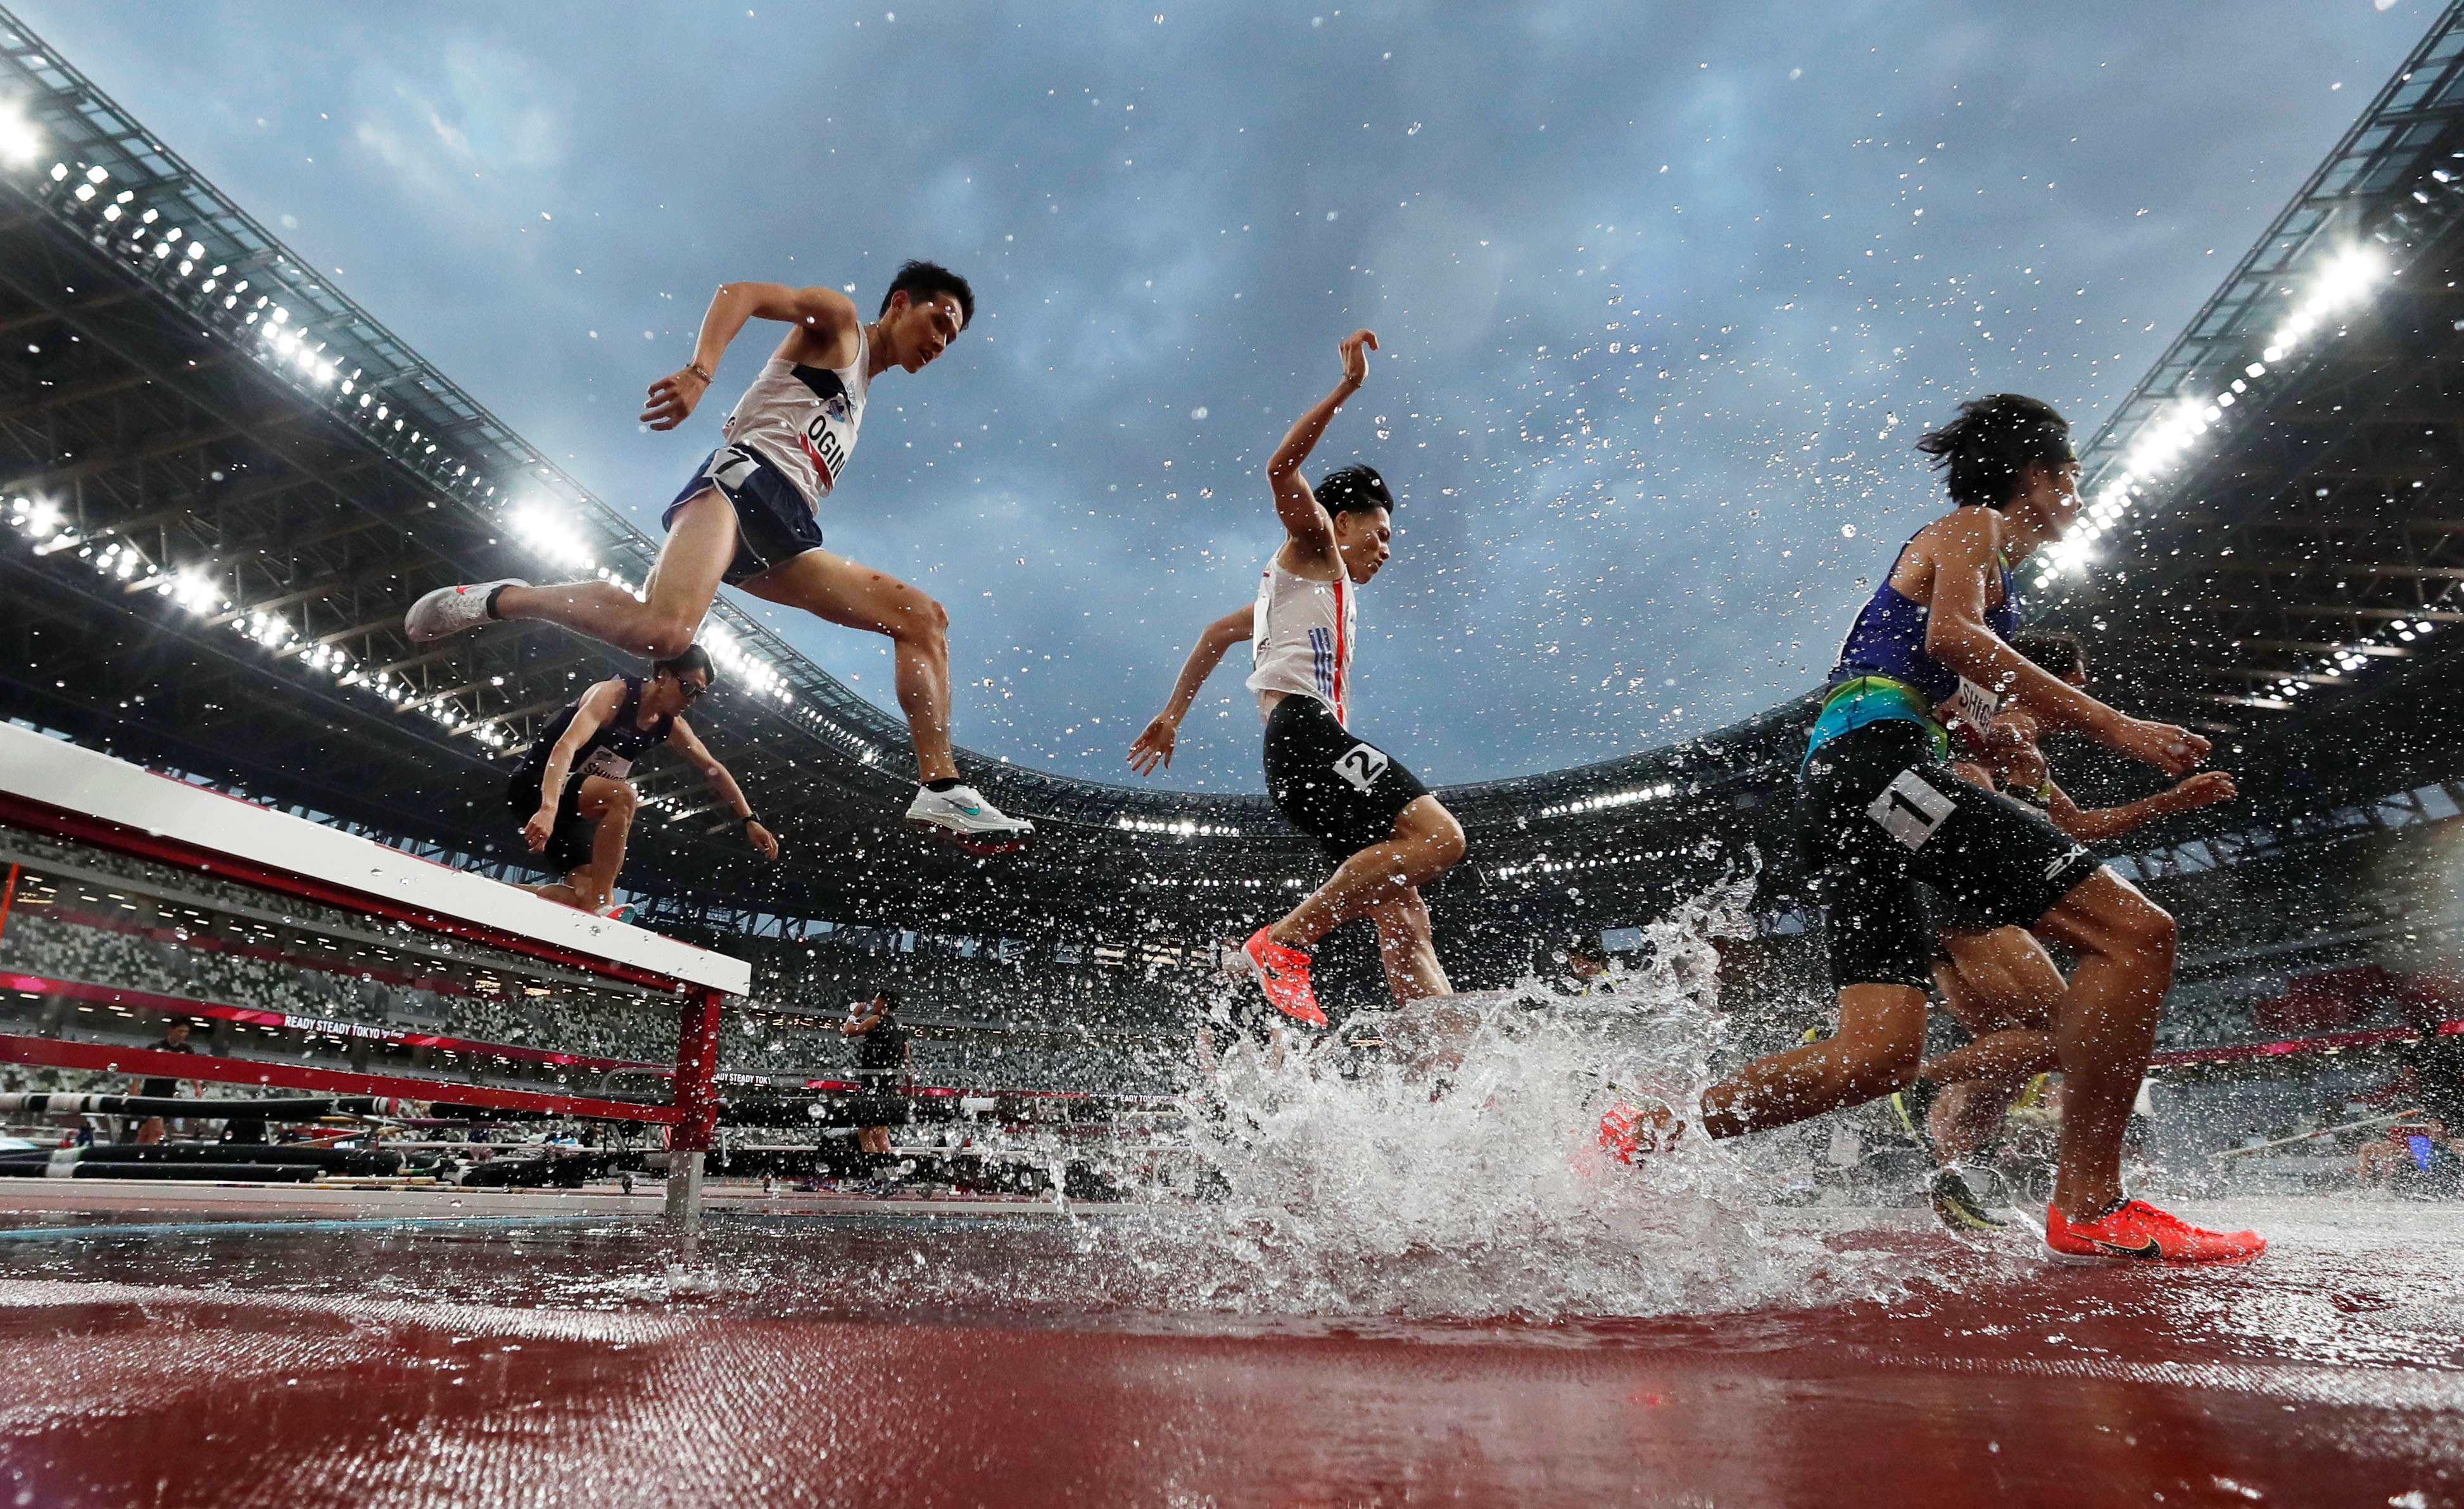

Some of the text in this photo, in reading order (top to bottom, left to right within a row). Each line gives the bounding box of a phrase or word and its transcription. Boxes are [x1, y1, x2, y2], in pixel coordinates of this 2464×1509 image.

[808, 415, 845, 479] OGIN
[714, 448, 750, 474] 7
[1345, 751, 1384, 780] 2
[1889, 789, 1935, 827] 1
[284, 1015, 316, 1030] READY
[316, 1020, 351, 1035] STEADY
[351, 1025, 380, 1039] TOKYO
[730, 1073, 754, 1083] STEADY
